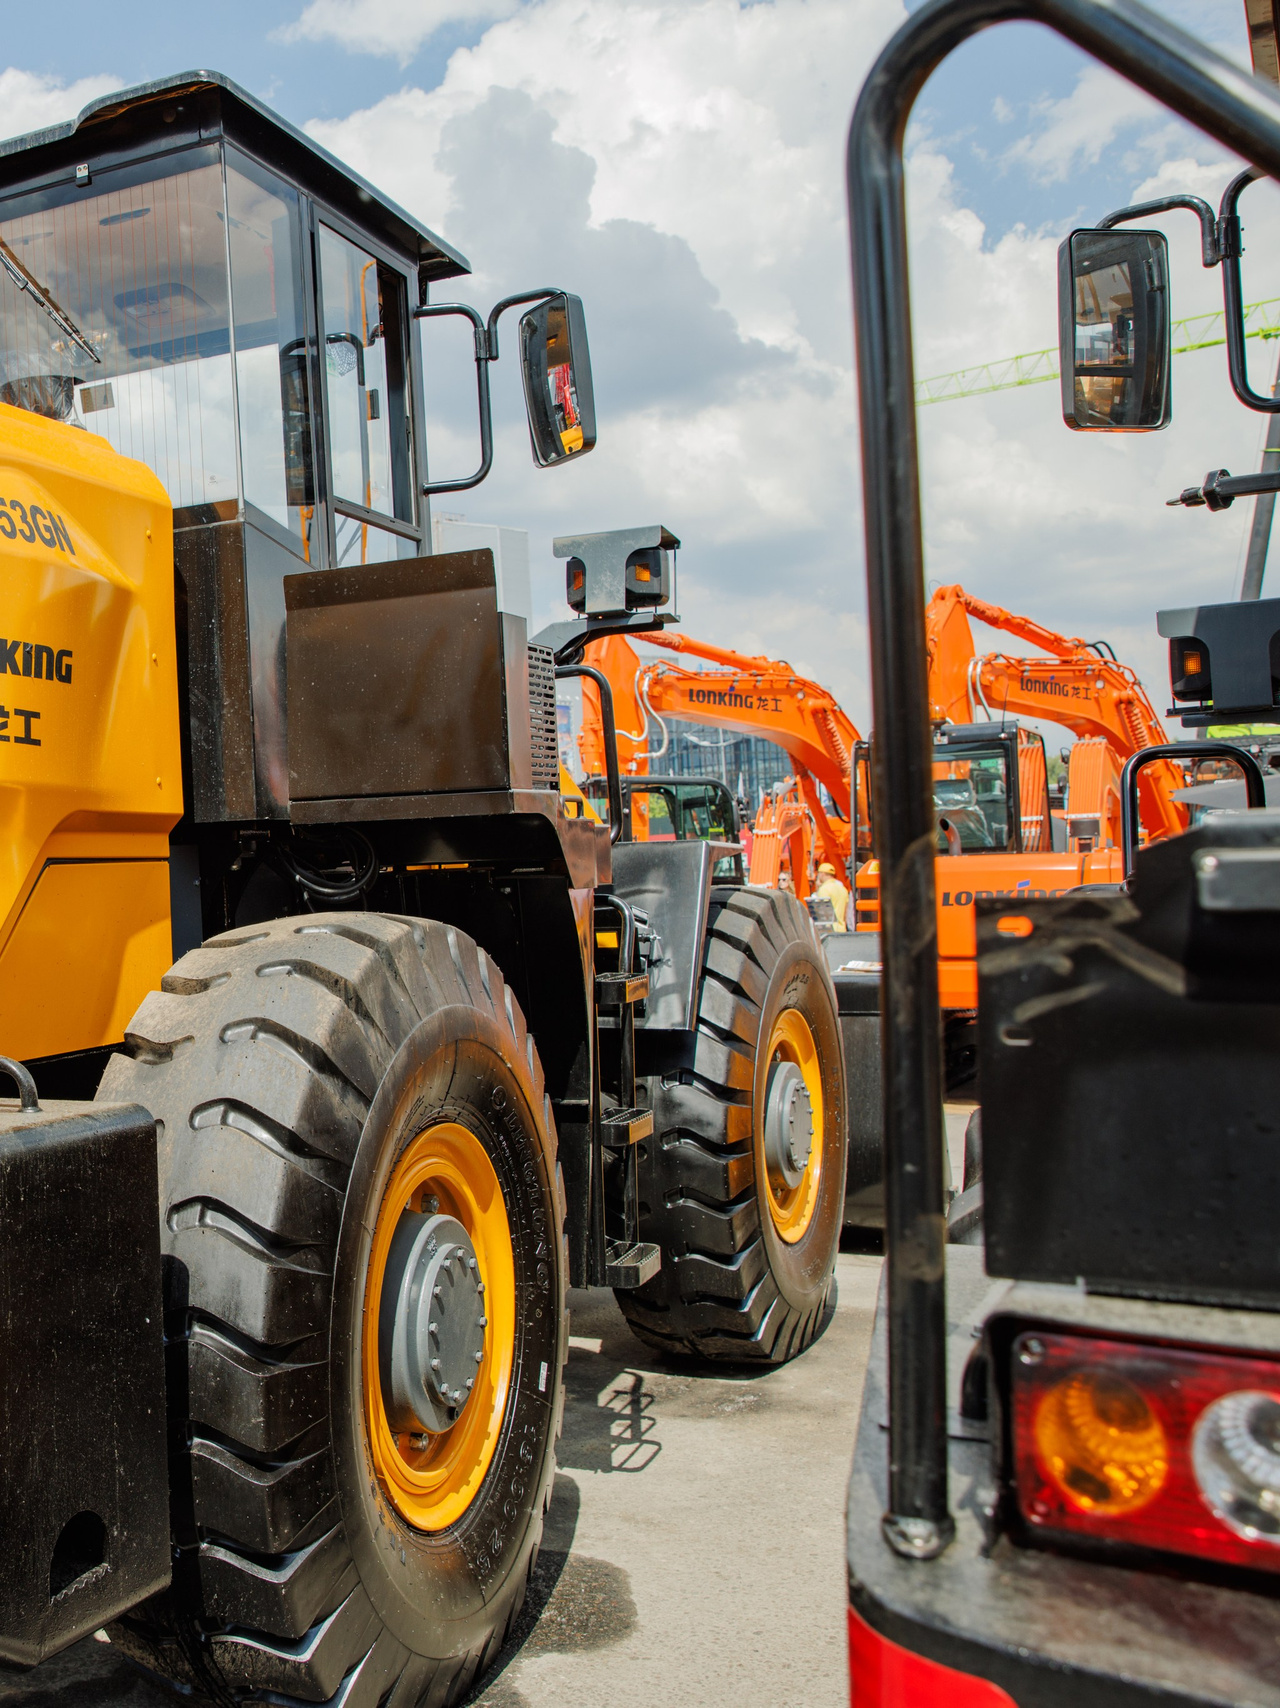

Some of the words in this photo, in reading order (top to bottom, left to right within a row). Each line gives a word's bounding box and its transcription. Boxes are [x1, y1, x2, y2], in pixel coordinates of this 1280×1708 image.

[1020, 675, 1068, 697] LONKING
[688, 686, 754, 709] LONKING
[757, 696, 783, 712] 龙工
